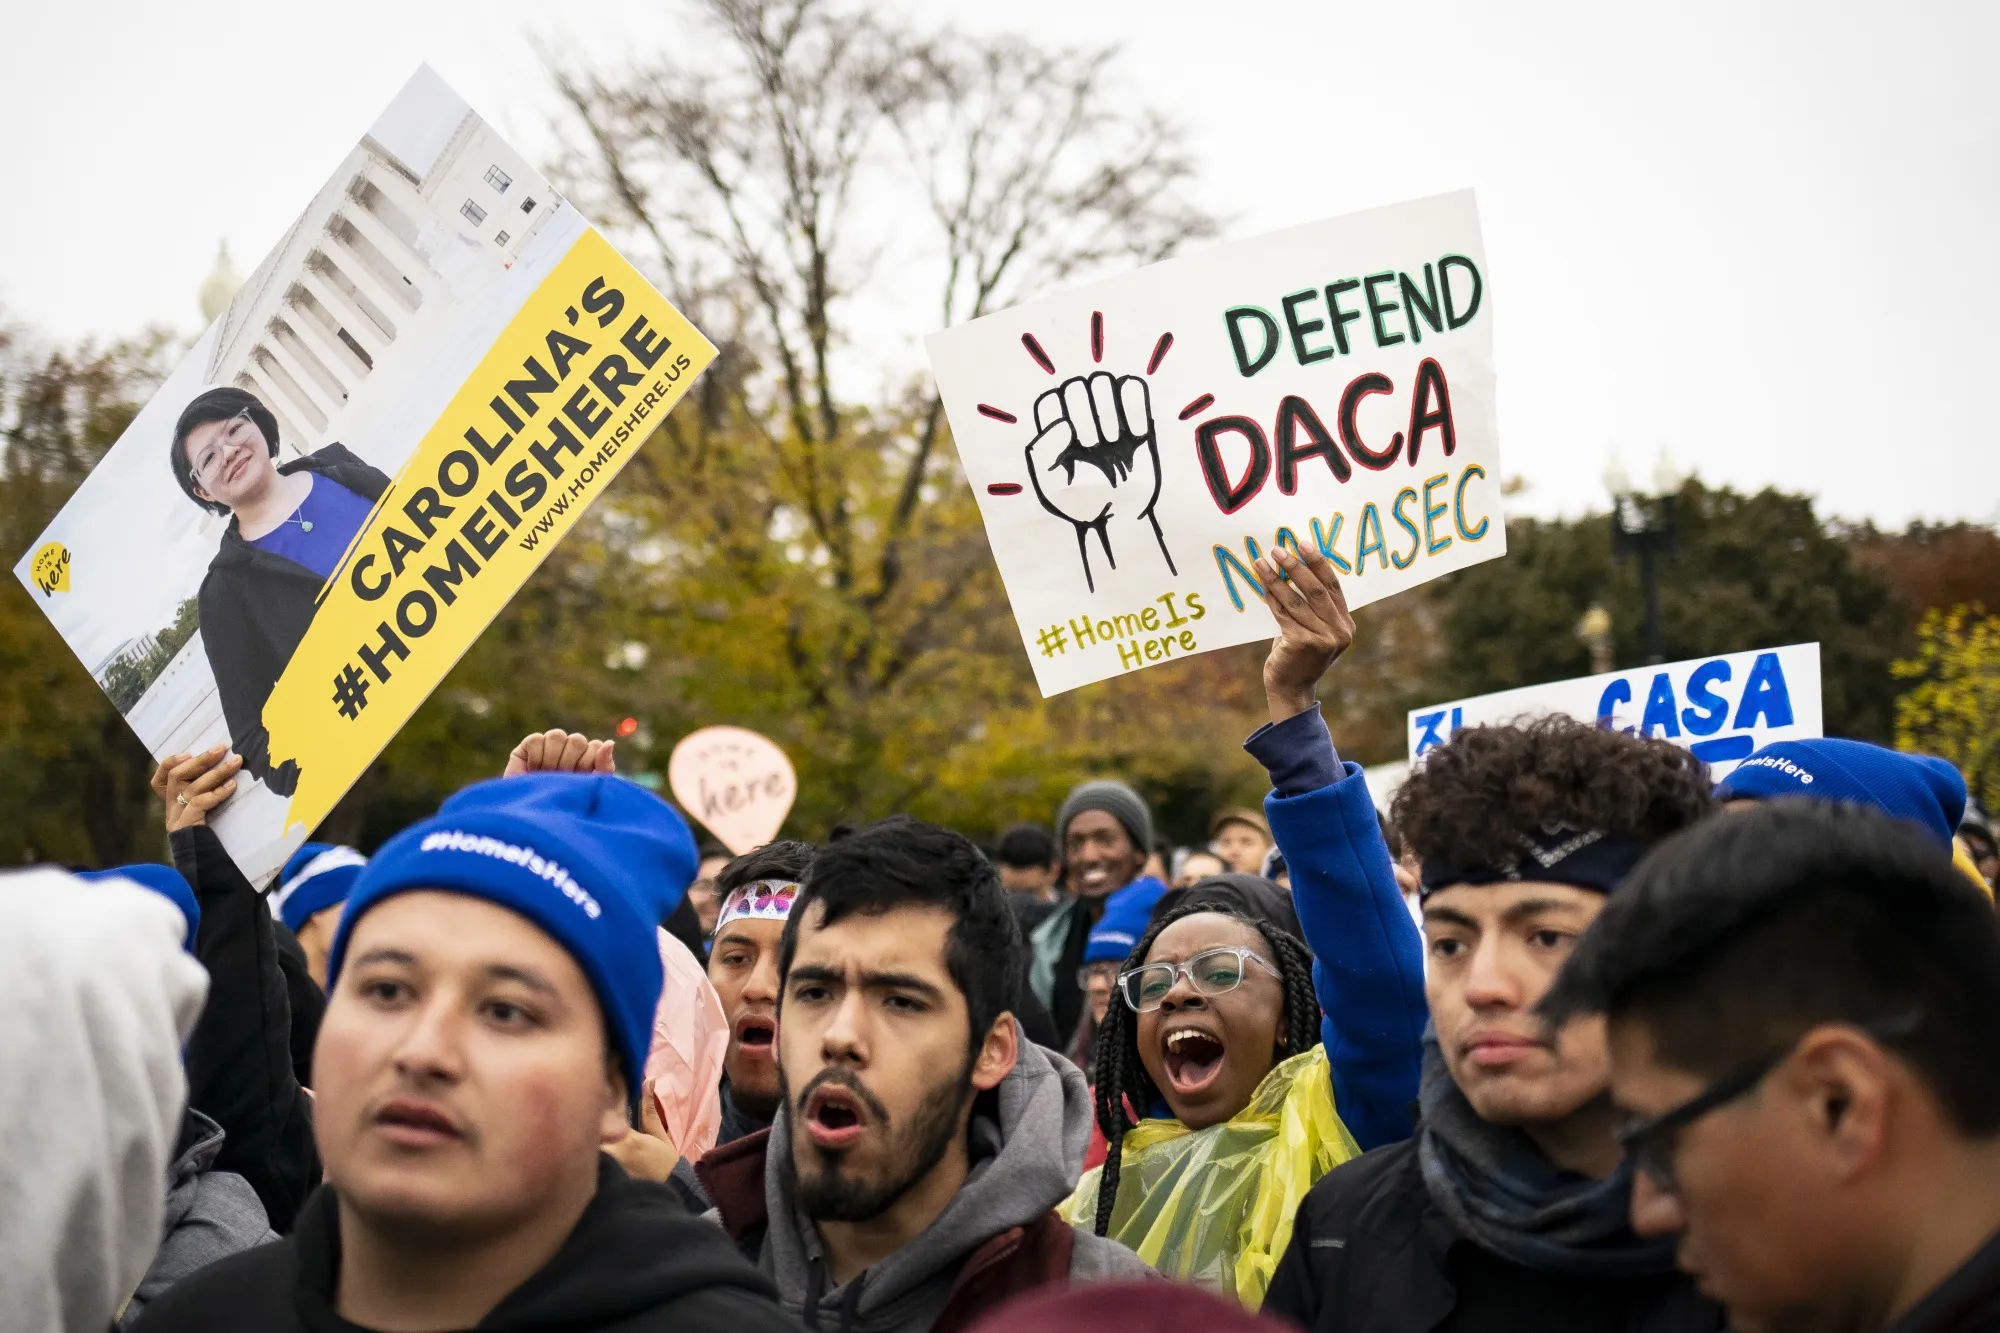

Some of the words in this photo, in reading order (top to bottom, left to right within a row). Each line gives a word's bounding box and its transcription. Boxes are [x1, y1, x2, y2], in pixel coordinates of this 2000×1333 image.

[1222, 253, 1483, 378] DEFEND
[350, 275, 626, 602] CAROLINA'S
[519, 354, 691, 551] WWW.HOMEISHERE.US
[1195, 357, 1456, 516] DACA
[35, 548, 55, 572] HOME
[331, 314, 672, 722] #HOMEISHERE
[1213, 463, 1490, 613] NAKASEC
[38, 548, 72, 598] here
[44, 560, 53, 570] IS
[1036, 591, 1206, 658] #HomeIs
[1116, 630, 1197, 670] Here
[1595, 652, 1794, 739] CASA
[698, 772, 787, 819] here
